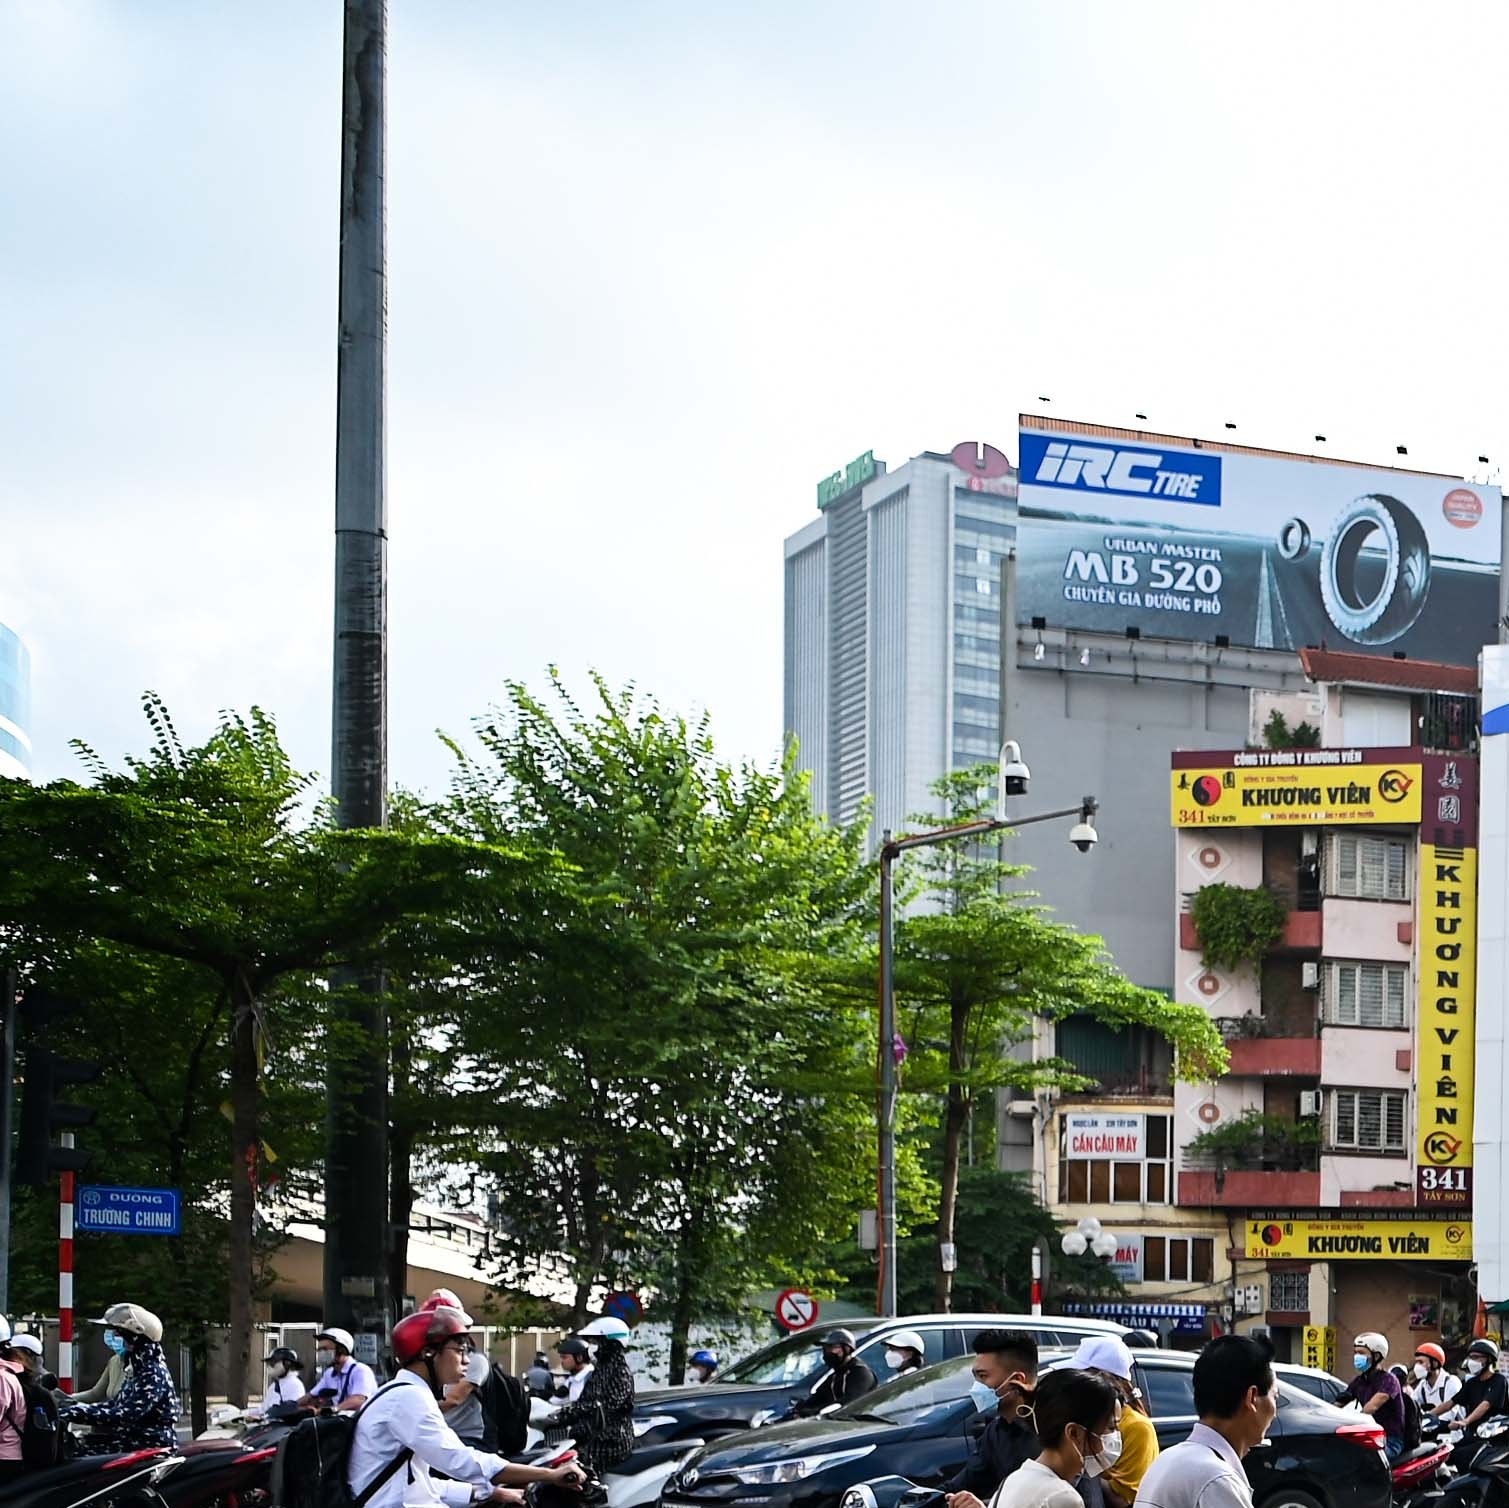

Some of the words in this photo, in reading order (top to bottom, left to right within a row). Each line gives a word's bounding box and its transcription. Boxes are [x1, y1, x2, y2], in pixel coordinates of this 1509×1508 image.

[1153, 470, 1203, 499] TIRE
[1105, 538, 1158, 556] URBAN
[1162, 543, 1222, 562] MASTER
[1064, 550, 1140, 586] MB
[1149, 559, 1222, 594] 520
[1064, 583, 1116, 605] CHUYÊN
[1119, 591, 1142, 607] GIA
[1194, 594, 1222, 615] PHỐ
[1259, 753, 1269, 766] TY
[1341, 749, 1362, 763] VIÊN
[1242, 786, 1321, 807] KHƯƠNG
[1327, 781, 1371, 805] VIÊN
[1179, 809, 1204, 823] 341
[1434, 864, 1462, 1015] KHƯƠNG
[1434, 1027, 1462, 1125] VIÊN
[1116, 1134, 1137, 1152] MÁY
[1421, 1166, 1468, 1190] 341
[83, 1206, 130, 1226] TRƯỜNG
[135, 1211, 171, 1227] CHINH
[1116, 1244, 1139, 1263] MÁY
[1251, 1247, 1270, 1258] 341
[1308, 1235, 1382, 1254] KHƯƠNG
[1388, 1232, 1430, 1254] VIÊN
